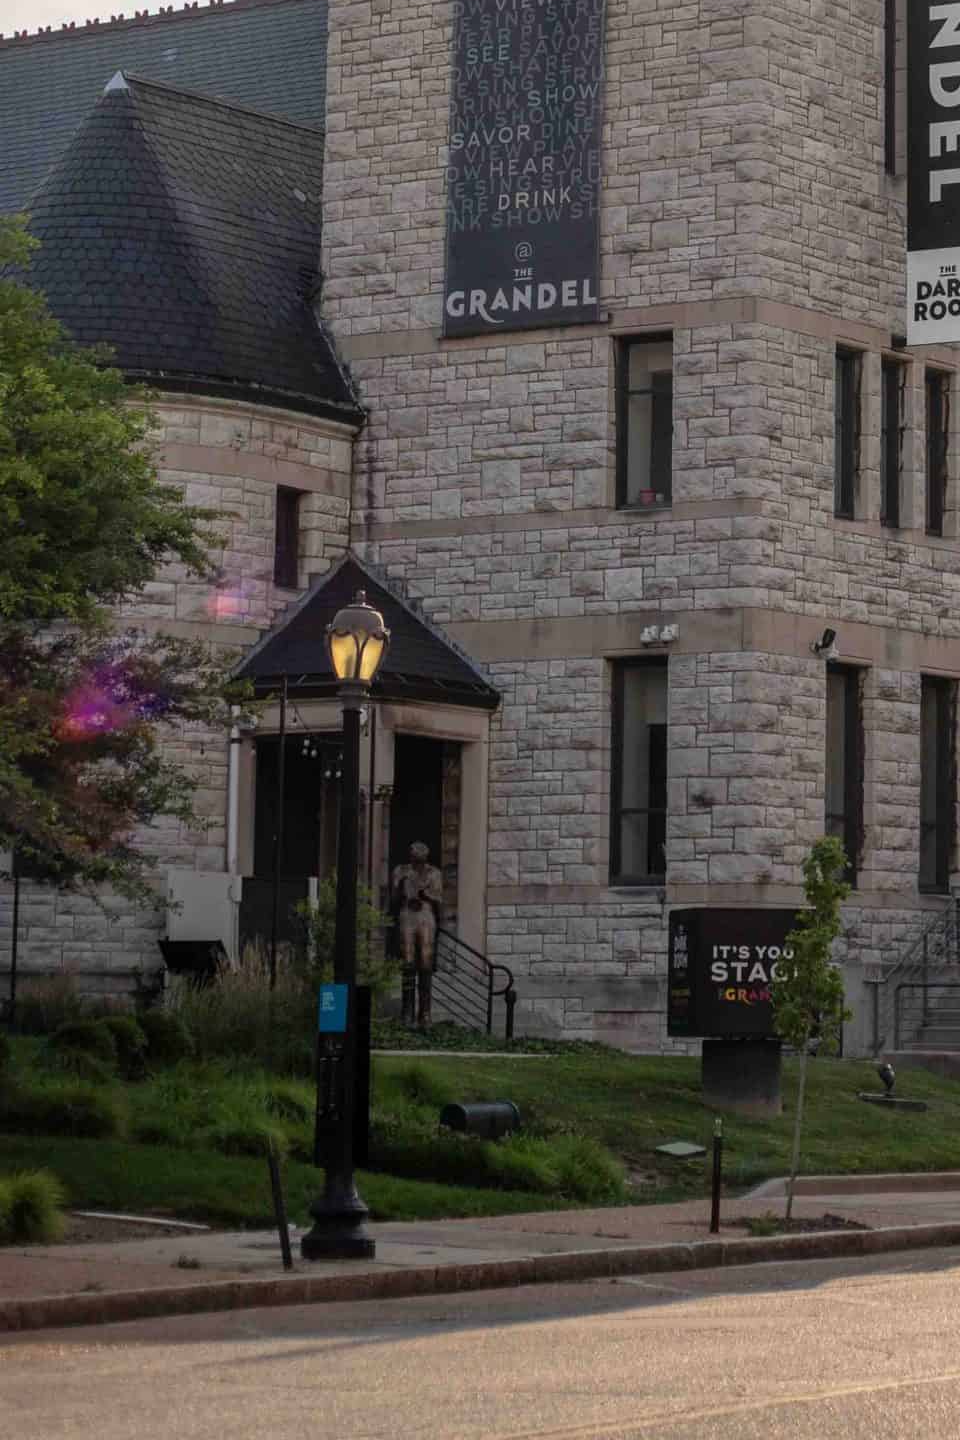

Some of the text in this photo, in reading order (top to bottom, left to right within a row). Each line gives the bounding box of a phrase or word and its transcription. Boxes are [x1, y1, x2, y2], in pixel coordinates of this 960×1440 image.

[480, 8, 536, 28] SING
[521, 18, 579, 41] PLAY
[466, 33, 597, 64] SEE SAVOR
[478, 75, 534, 96] SING
[528, 83, 598, 106] SHOW
[496, 105, 565, 127] SHOW
[451, 116, 593, 149] SAVOR DINE
[465, 134, 590, 163] VIEW PLAY
[490, 157, 554, 177] HEAR
[475, 176, 531, 195] SING
[498, 186, 571, 210] DRINK
[491, 208, 561, 226] SHOW
[513, 267, 534, 277] THE
[940, 265, 956, 273] THE
[446, 279, 598, 323] GRANDEL
[712, 944, 795, 959] IT'S YOU
[711, 961, 799, 983] STAG
